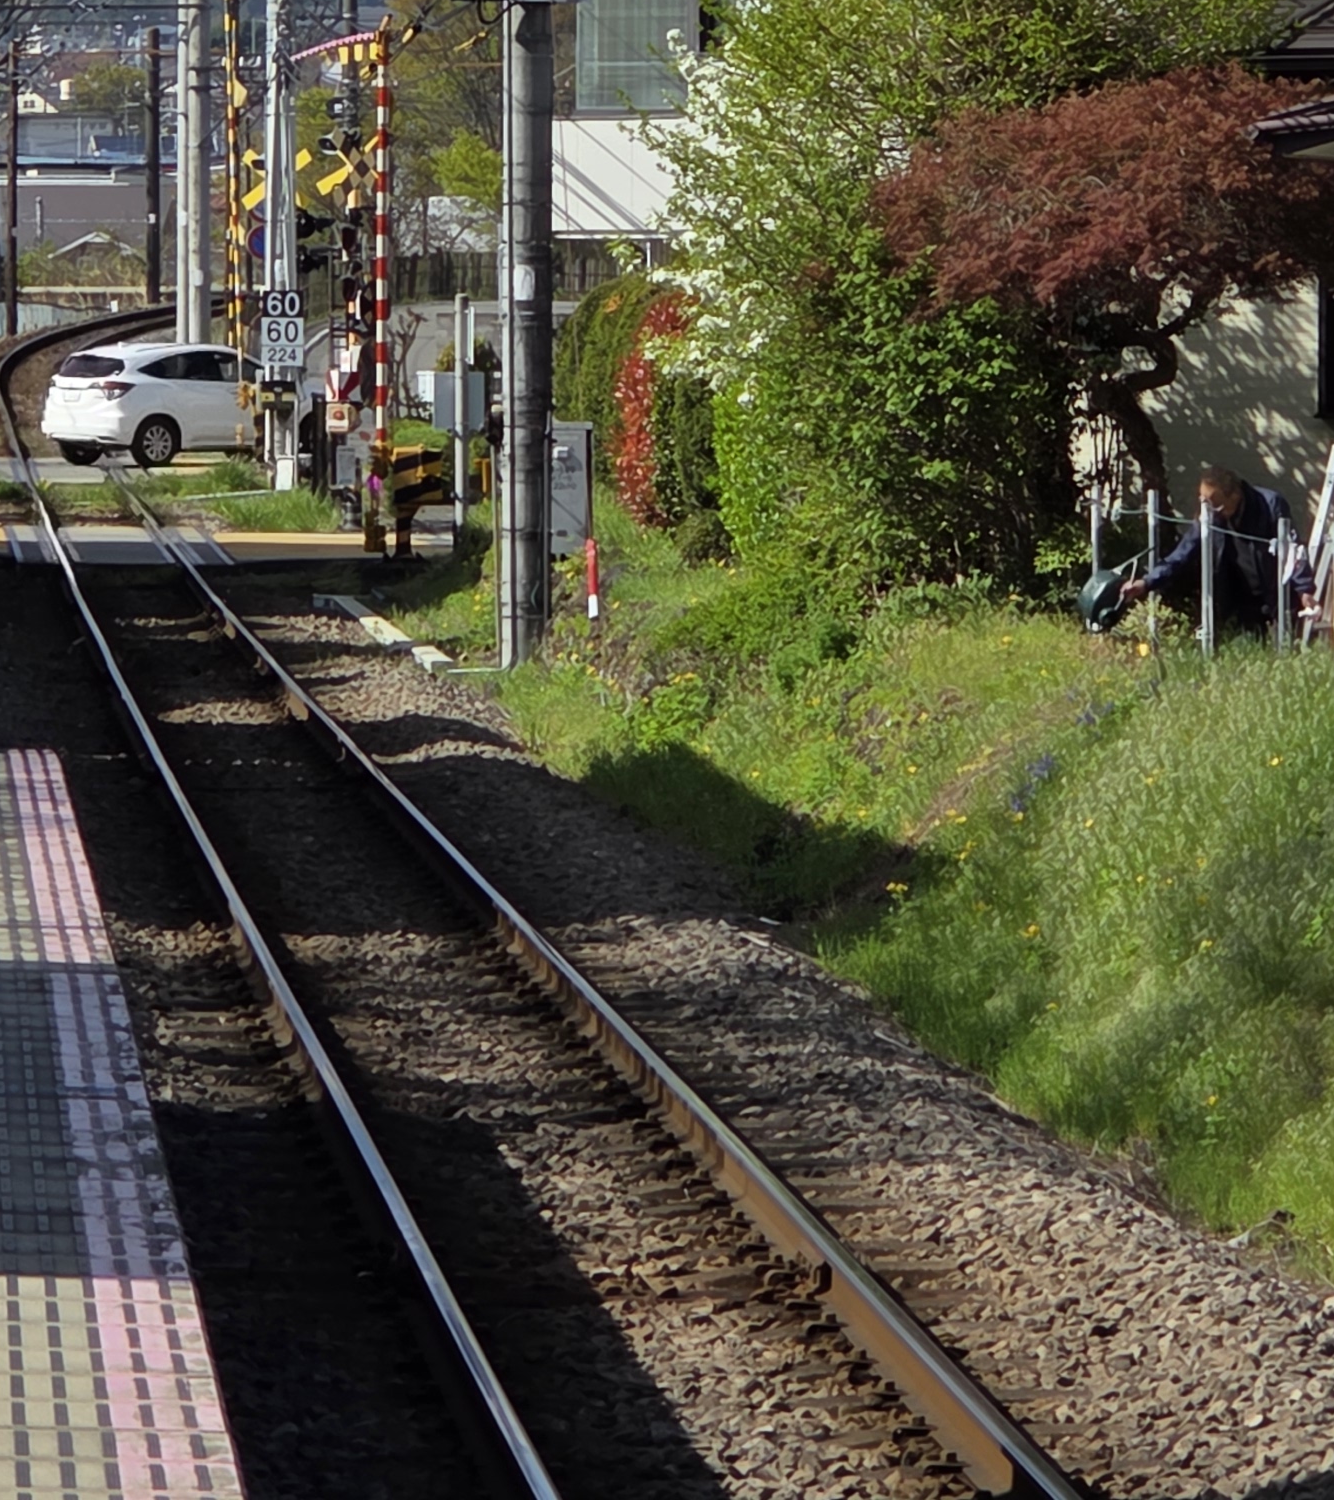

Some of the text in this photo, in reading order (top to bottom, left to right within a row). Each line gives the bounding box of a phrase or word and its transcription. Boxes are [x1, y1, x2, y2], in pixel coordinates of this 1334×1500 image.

[267, 292, 300, 317] 60
[267, 320, 299, 343] 60
[267, 347, 297, 362] 224
